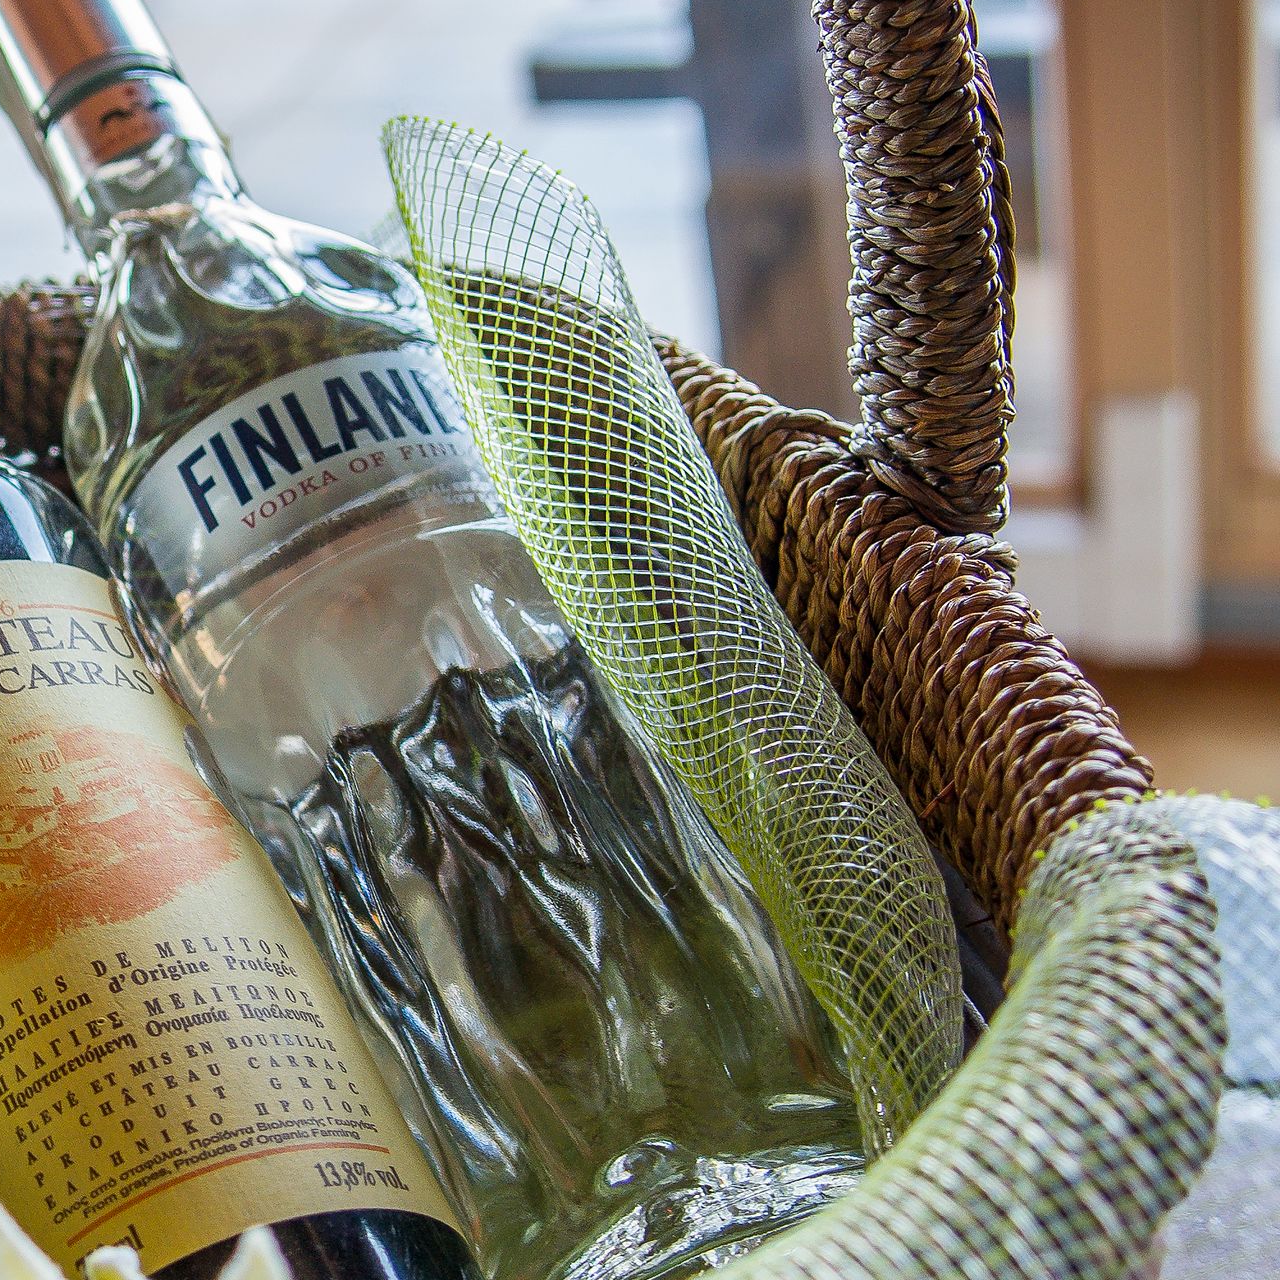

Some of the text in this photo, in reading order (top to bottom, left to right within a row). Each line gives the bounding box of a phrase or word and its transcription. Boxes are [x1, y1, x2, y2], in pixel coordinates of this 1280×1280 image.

[240, 469, 338, 530] VODKA
[349, 450, 388, 475] OF
[91, 951, 132, 978] DE
[155, 936, 290, 960] MELITON
[223, 955, 298, 978] Protégée
[142, 984, 314, 1018] ΜΕΛΙΤΩΝΟΣ
[1, 1003, 325, 1117] Προστατευόμενη Ονομασία Προέλευσης
[90, 1072, 118, 1096] ET
[129, 1051, 173, 1077] MIS
[185, 1041, 215, 1059] EN
[225, 1033, 337, 1053] BOUTEILLE
[27, 1055, 348, 1166] AU CHÂTEAU CARRAS
[34, 1076, 360, 1188] PRODUIT GREC
[44, 1112, 224, 1211] ΕΛΛΗΝΙΚΟ
[82, 1193, 118, 1219] From
[173, 1143, 237, 1171] Products
[240, 1137, 254, 1149] of
[256, 1130, 310, 1145] Organic
[310, 1128, 361, 1141] Farming
[314, 1161, 376, 1192] 13,8%
